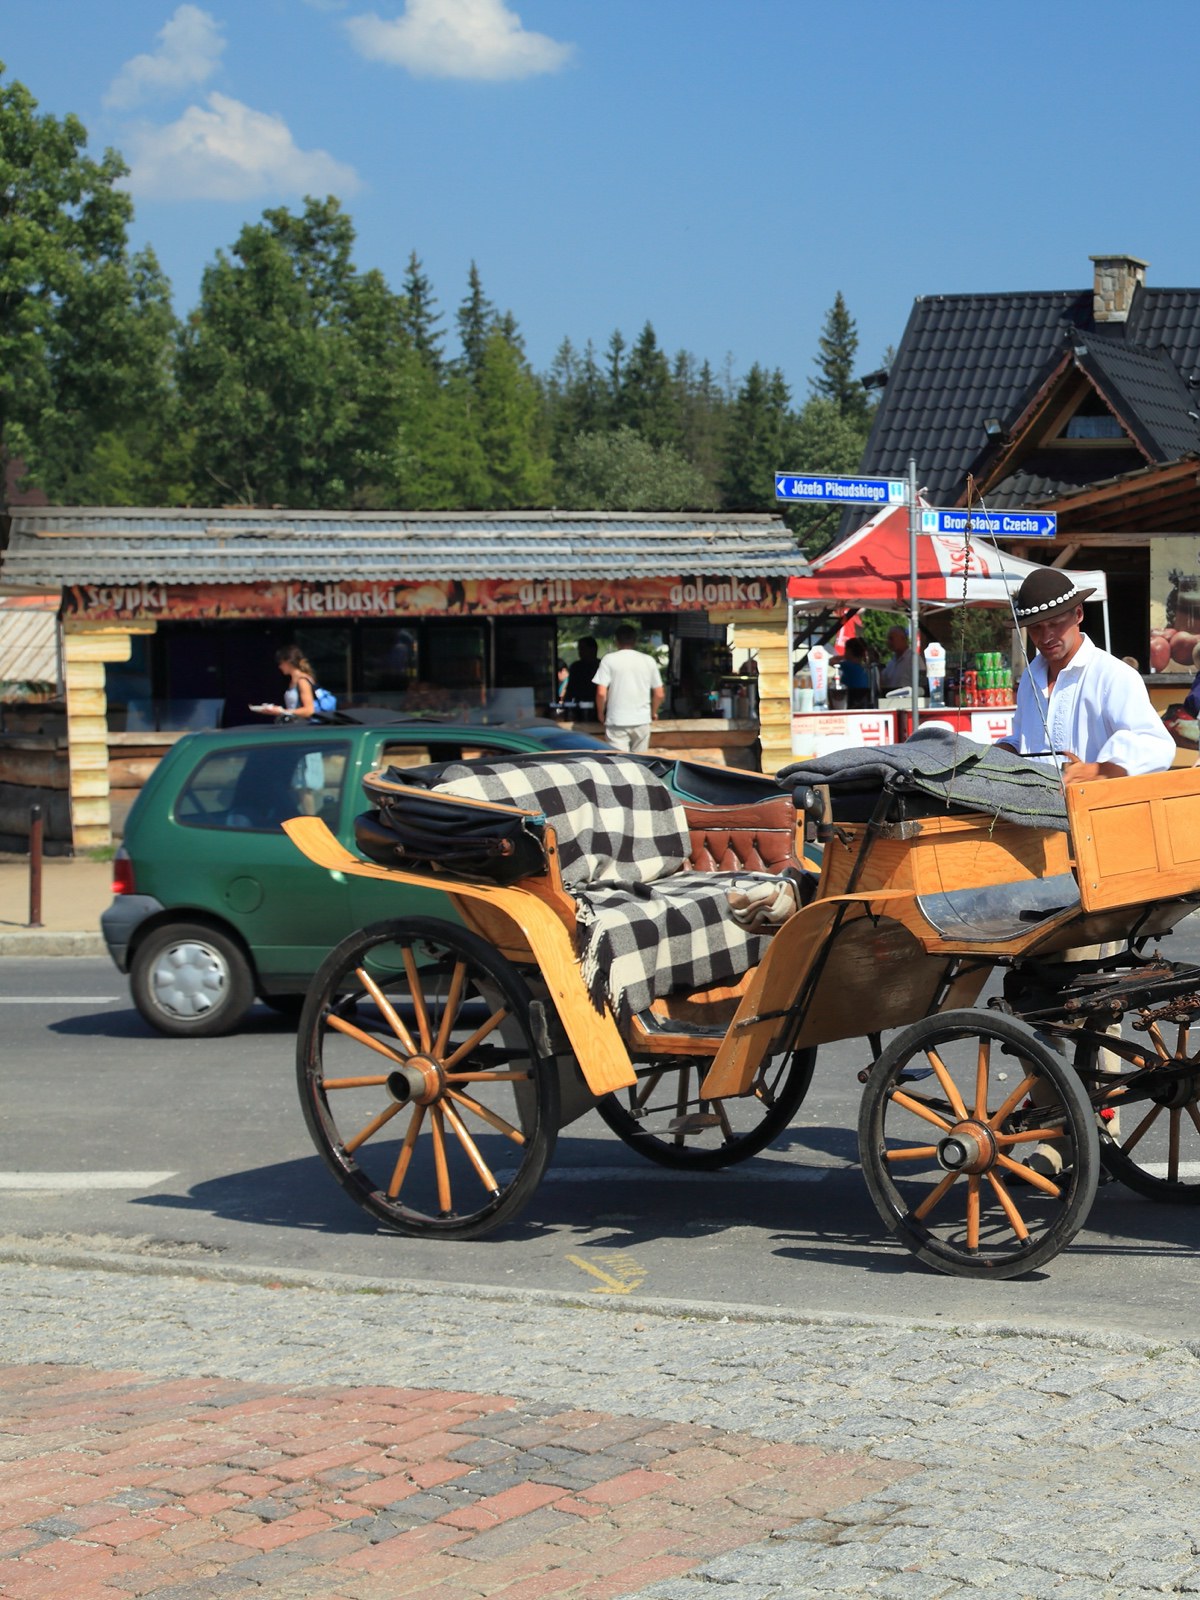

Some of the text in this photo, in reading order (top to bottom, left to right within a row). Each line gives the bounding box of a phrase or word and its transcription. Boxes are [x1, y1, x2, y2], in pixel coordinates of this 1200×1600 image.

[792, 480, 885, 501] Józefa Piłsudskiego
[943, 515, 1038, 531] Bronsława Czecha
[286, 585, 397, 611] kiełbaski
[519, 578, 573, 605] grill
[669, 576, 762, 605] golonka
